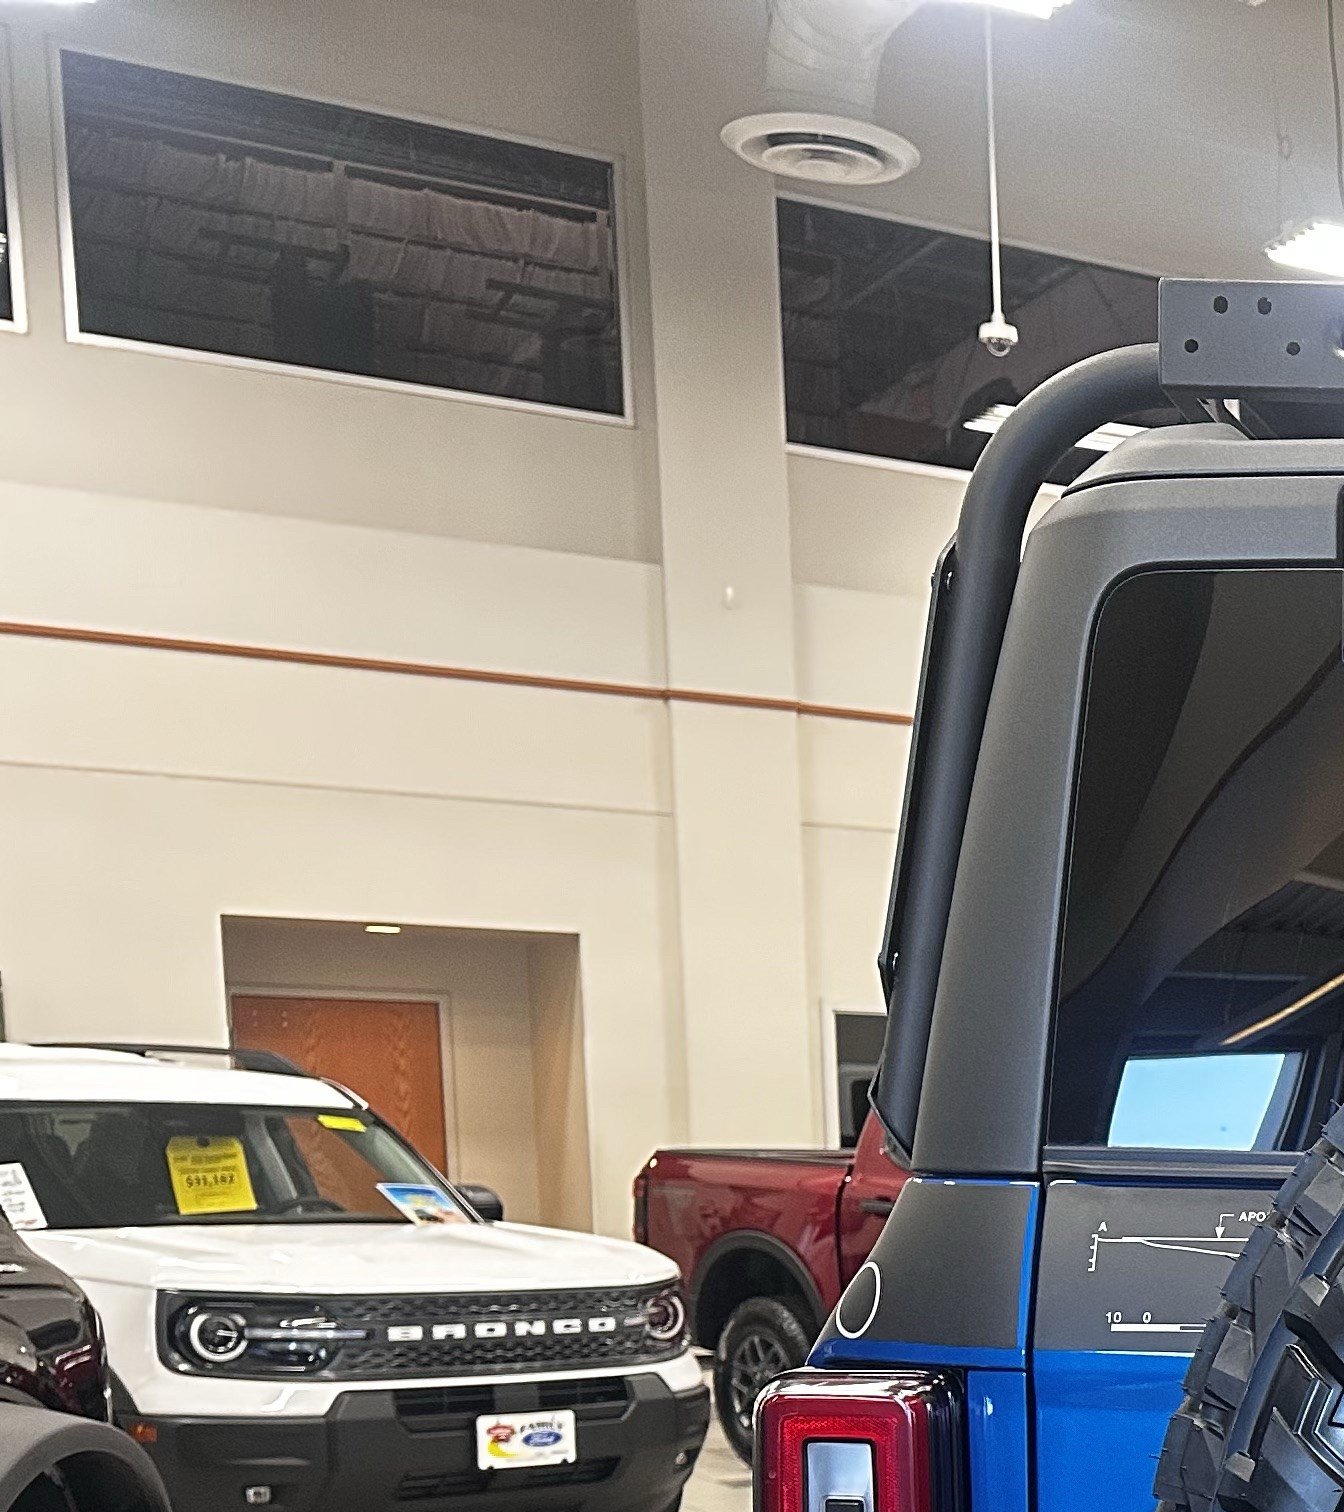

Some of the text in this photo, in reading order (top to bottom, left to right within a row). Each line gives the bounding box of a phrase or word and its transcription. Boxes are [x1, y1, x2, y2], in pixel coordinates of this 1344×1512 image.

[1105, 1311, 1153, 1324] 10 0
[386, 1316, 617, 1342] BRONCO
